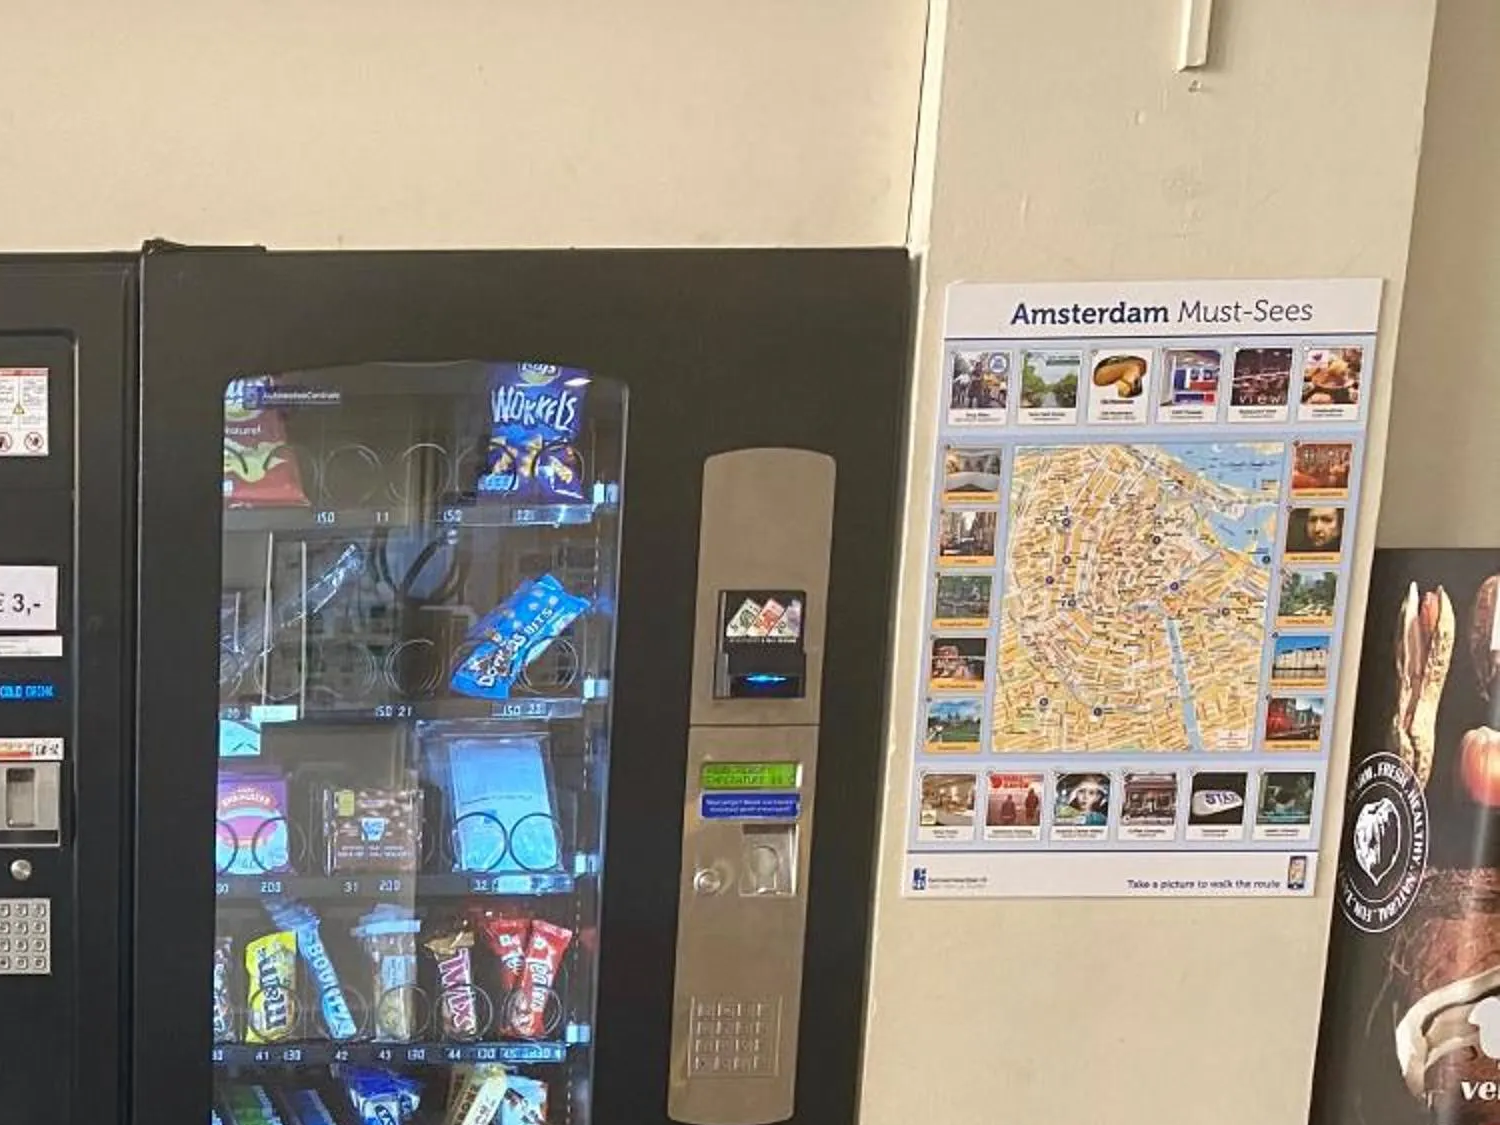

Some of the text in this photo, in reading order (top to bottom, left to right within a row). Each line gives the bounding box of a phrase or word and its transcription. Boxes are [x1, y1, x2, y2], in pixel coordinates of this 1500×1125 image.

[1011, 299, 1313, 325] Amsterdam Must-Sees
[491, 386, 577, 432] WOKKELS
[12, 592, 41, 616] 3,-
[1127, 879, 1150, 889] Take
[1160, 880, 1195, 891] picture
[1198, 880, 1209, 889] to
[1210, 879, 1233, 889] walk
[1235, 879, 1251, 889] the
[1253, 880, 1281, 889] route
[1461, 1081, 1500, 1100] ve
